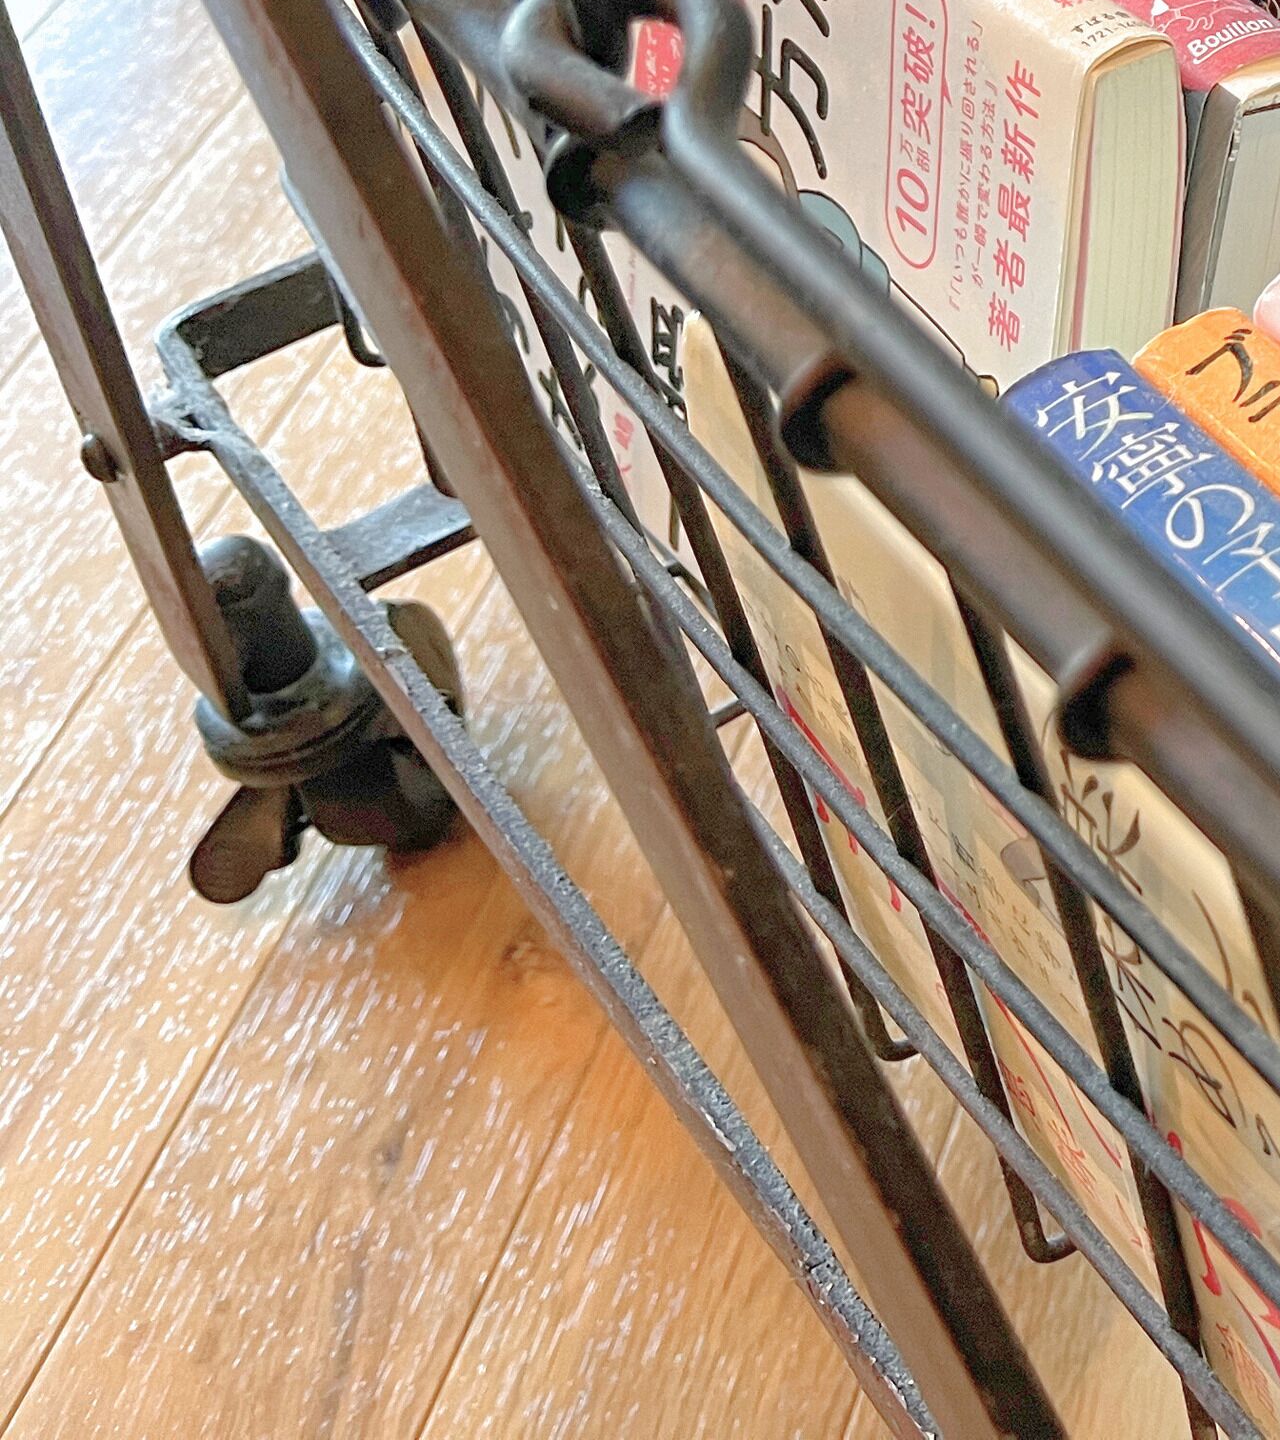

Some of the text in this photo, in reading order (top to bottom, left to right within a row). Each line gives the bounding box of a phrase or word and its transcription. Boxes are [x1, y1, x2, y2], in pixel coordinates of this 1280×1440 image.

[1187, 15, 1275, 58] Bouillon
[987, 59, 1045, 353] 著者最新作
